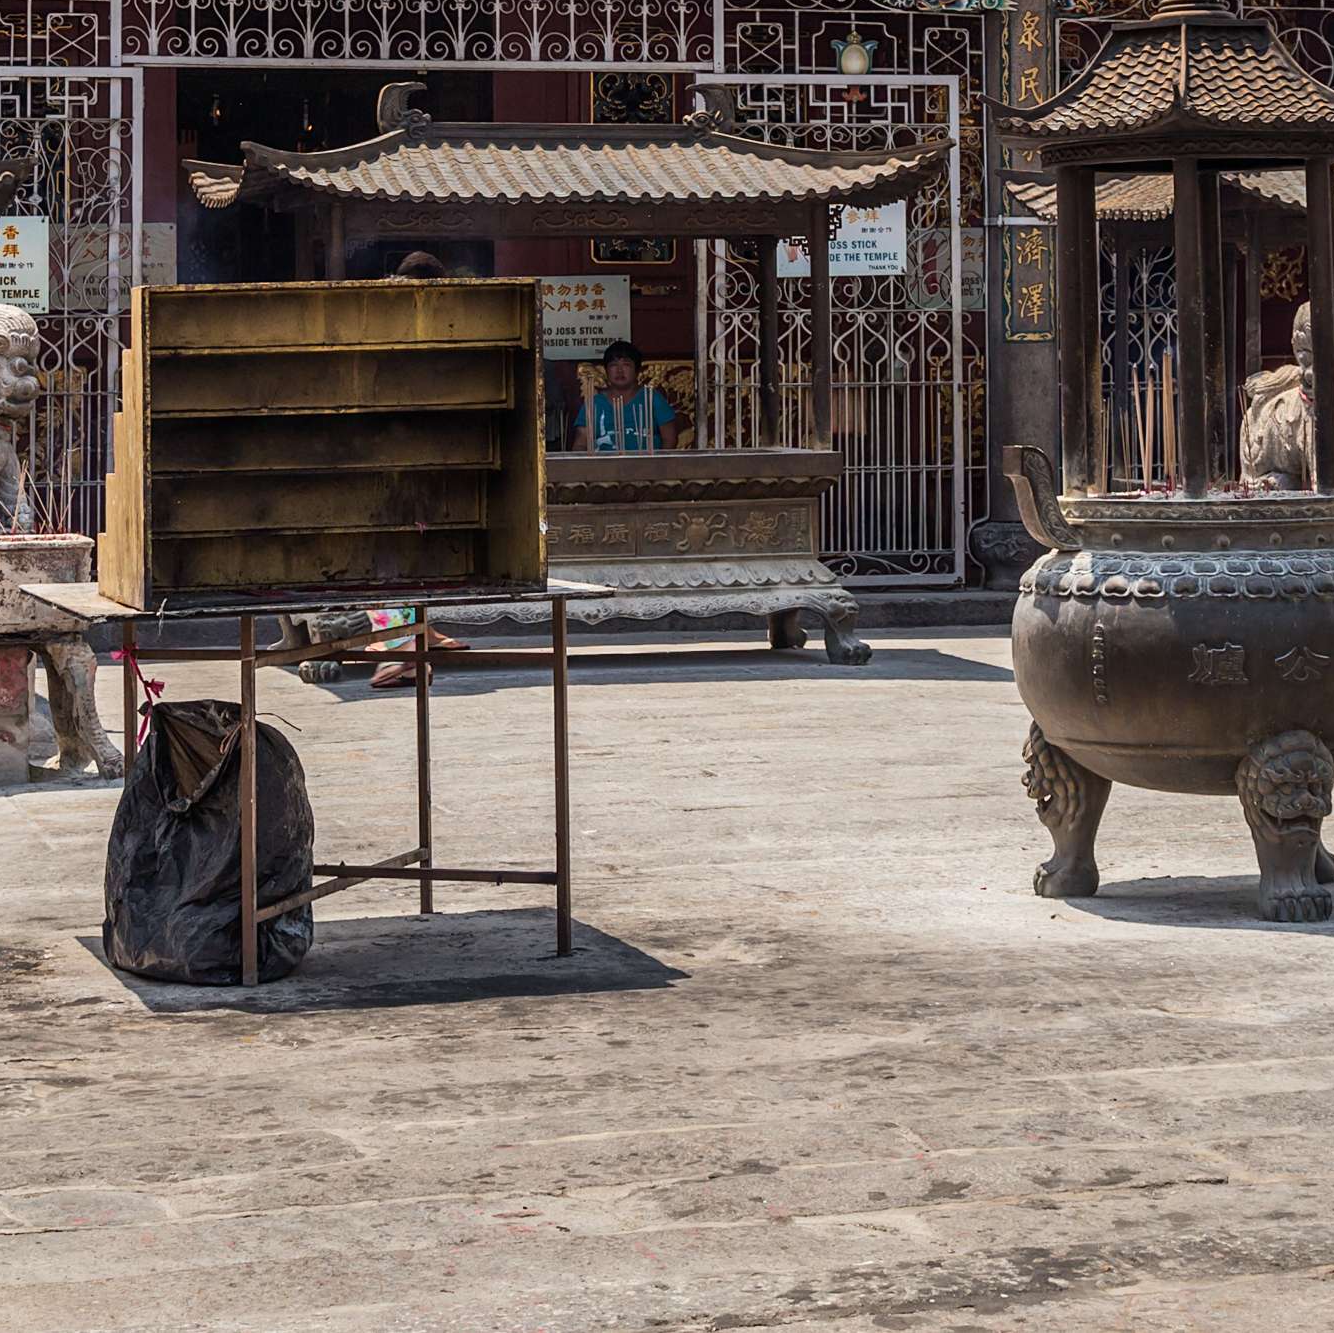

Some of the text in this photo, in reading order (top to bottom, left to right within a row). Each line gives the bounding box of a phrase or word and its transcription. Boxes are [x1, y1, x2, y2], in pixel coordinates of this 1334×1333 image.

[829, 240, 877, 250] OSS STICK
[844, 252, 860, 262] THE
[864, 252, 899, 261] TEMPLE
[1, 289, 40, 299] TEMPLE
[555, 327, 576, 335] JOSS
[579, 327, 603, 335] STICK
[544, 338, 571, 347] NSIDE
[572, 338, 588, 346] THE
